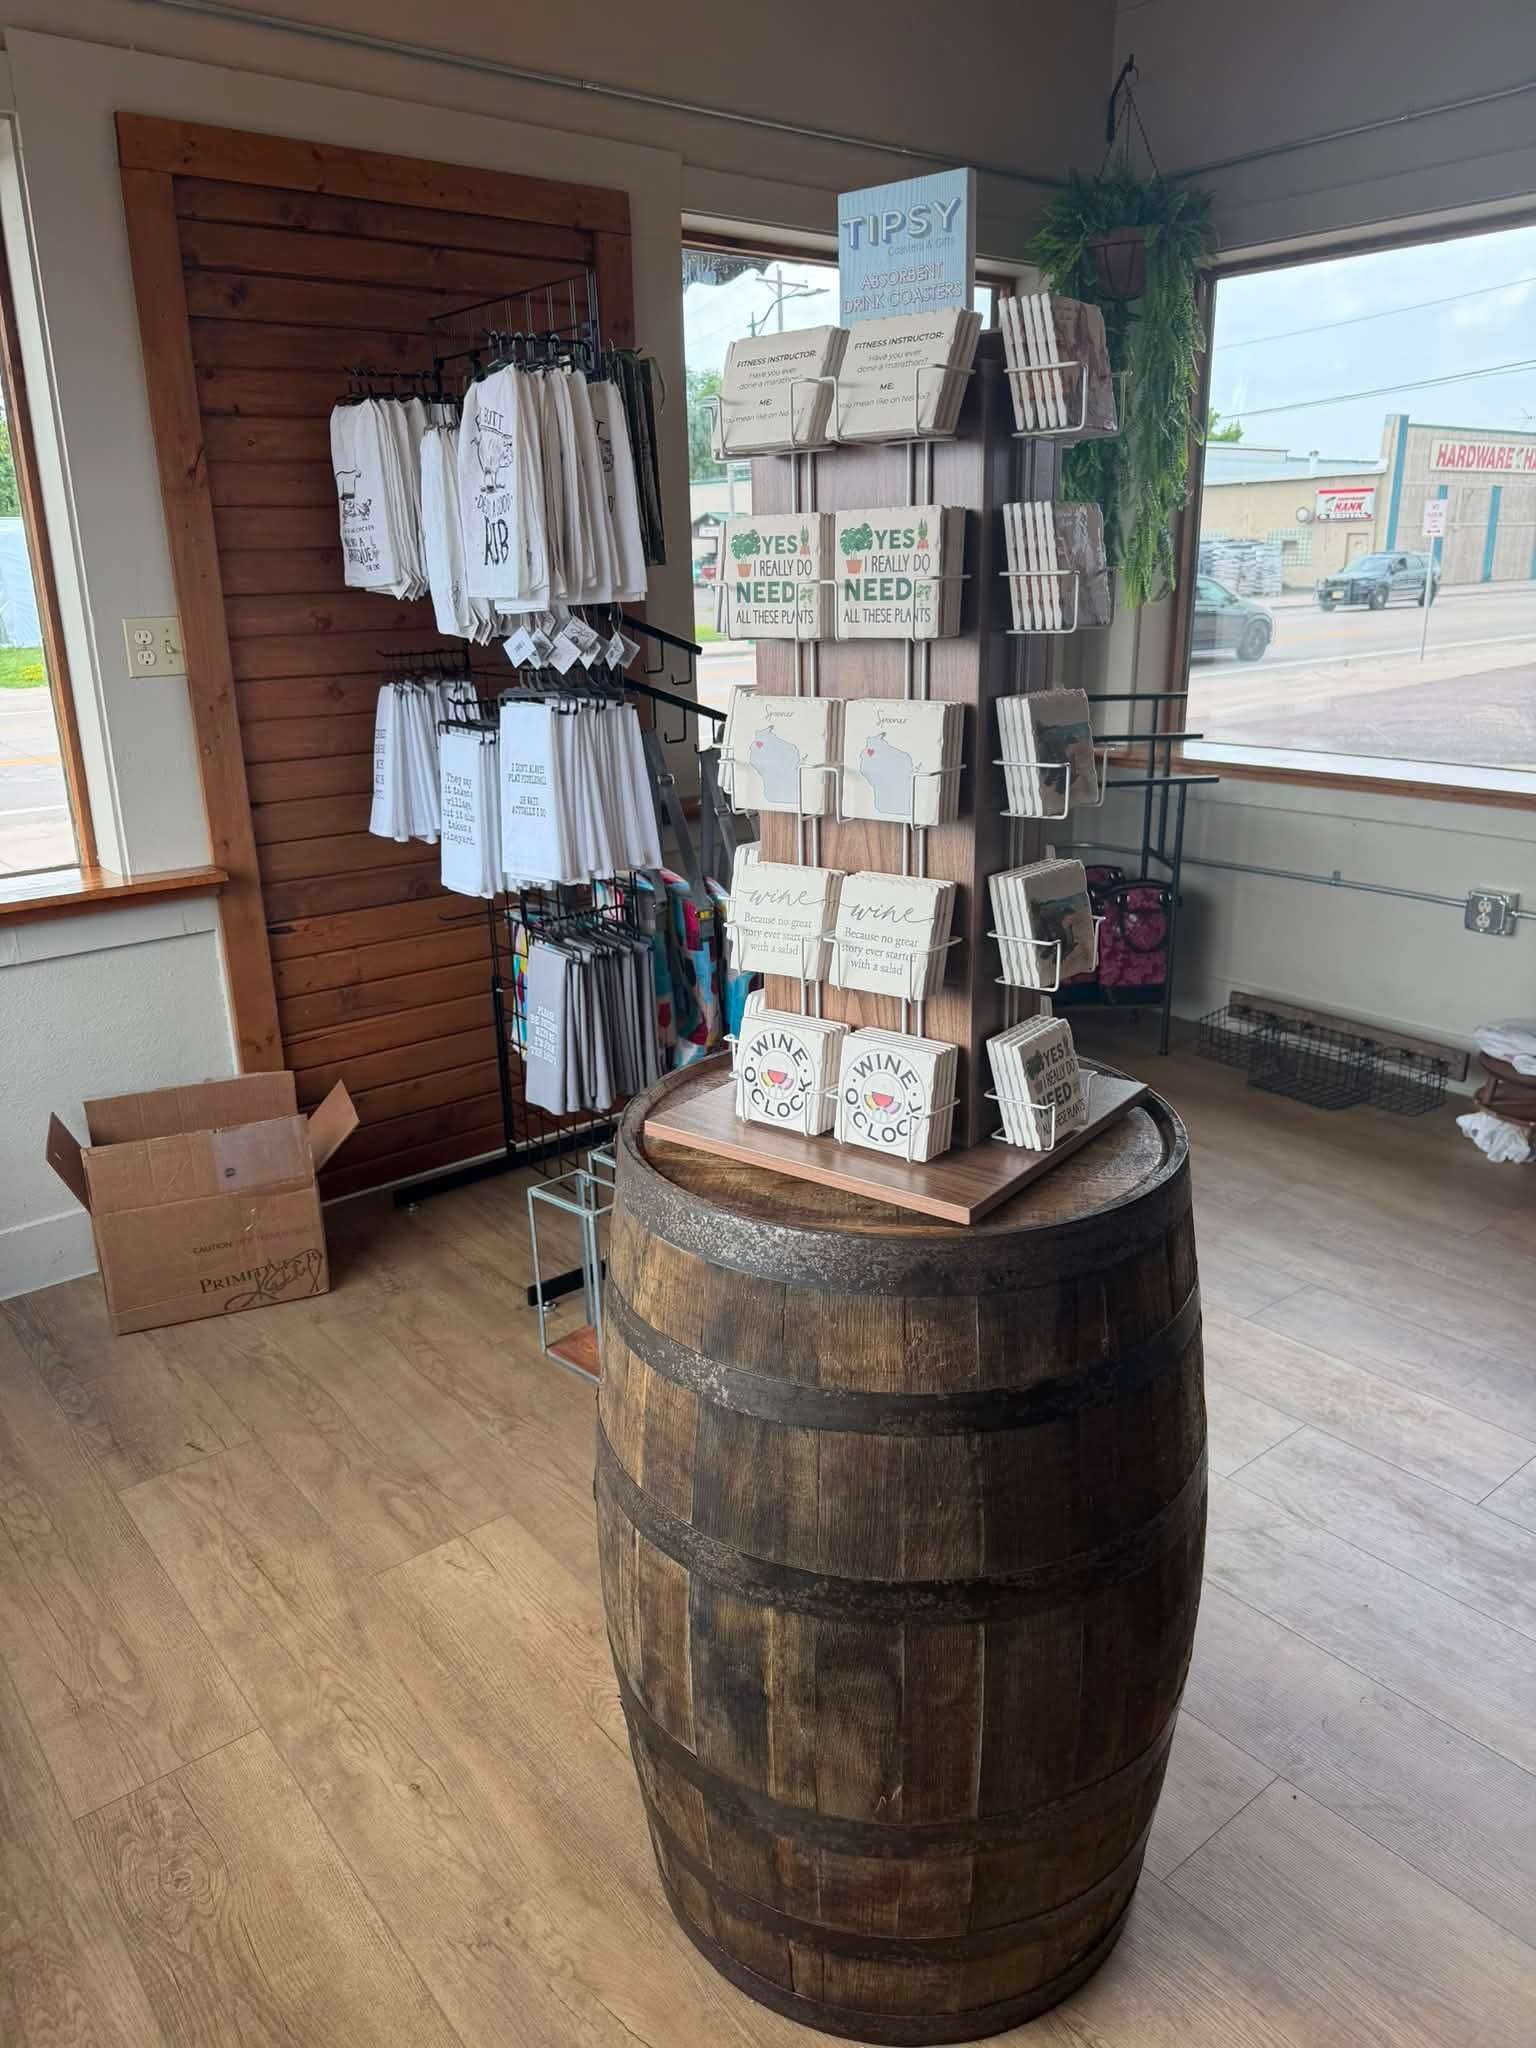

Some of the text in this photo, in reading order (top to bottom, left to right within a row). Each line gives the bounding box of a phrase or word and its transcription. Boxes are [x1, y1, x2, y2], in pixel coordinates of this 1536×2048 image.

[840, 197, 961, 250] TIPSY
[862, 263, 944, 290] ABSORBENT
[843, 280, 963, 313] DRINK COASTERS
[854, 331, 945, 351] FITNESS INSTRUCTOR:
[737, 357, 767, 368] FITNESS
[888, 352, 902, 361] you
[1436, 443, 1515, 469] HARDWARE
[1334, 502, 1363, 512] HANK
[760, 535, 798, 555] YES
[873, 529, 915, 550] YES
[753, 559, 812, 577] I REALLY DO
[864, 553, 931, 574] I REALLY DO
[736, 581, 795, 604] NEED
[844, 577, 912, 602] NEED
[736, 609, 814, 625] ALL THESE PLANTS
[843, 607, 931, 624] ALL THESE PLANTS
[737, 888, 827, 908] wine
[744, 912, 776, 925] Because
[791, 919, 812, 929] great
[840, 903, 936, 924] wine
[750, 940, 769, 952] with
[777, 943, 799, 955] salad
[845, 927, 919, 948] Because no great
[865, 948, 884, 957] ever
[850, 959, 870, 970] with
[880, 962, 903, 975] salad
[751, 1032, 808, 1067] WINE
[1043, 1042, 1064, 1067] YES
[853, 1053, 919, 1090] WINE
[1046, 1063, 1067, 1087] REALLY
[1066, 1058, 1076, 1075] DO
[1037, 1082, 1072, 1118] NEED
[193, 1241, 233, 1255] CAUTION
